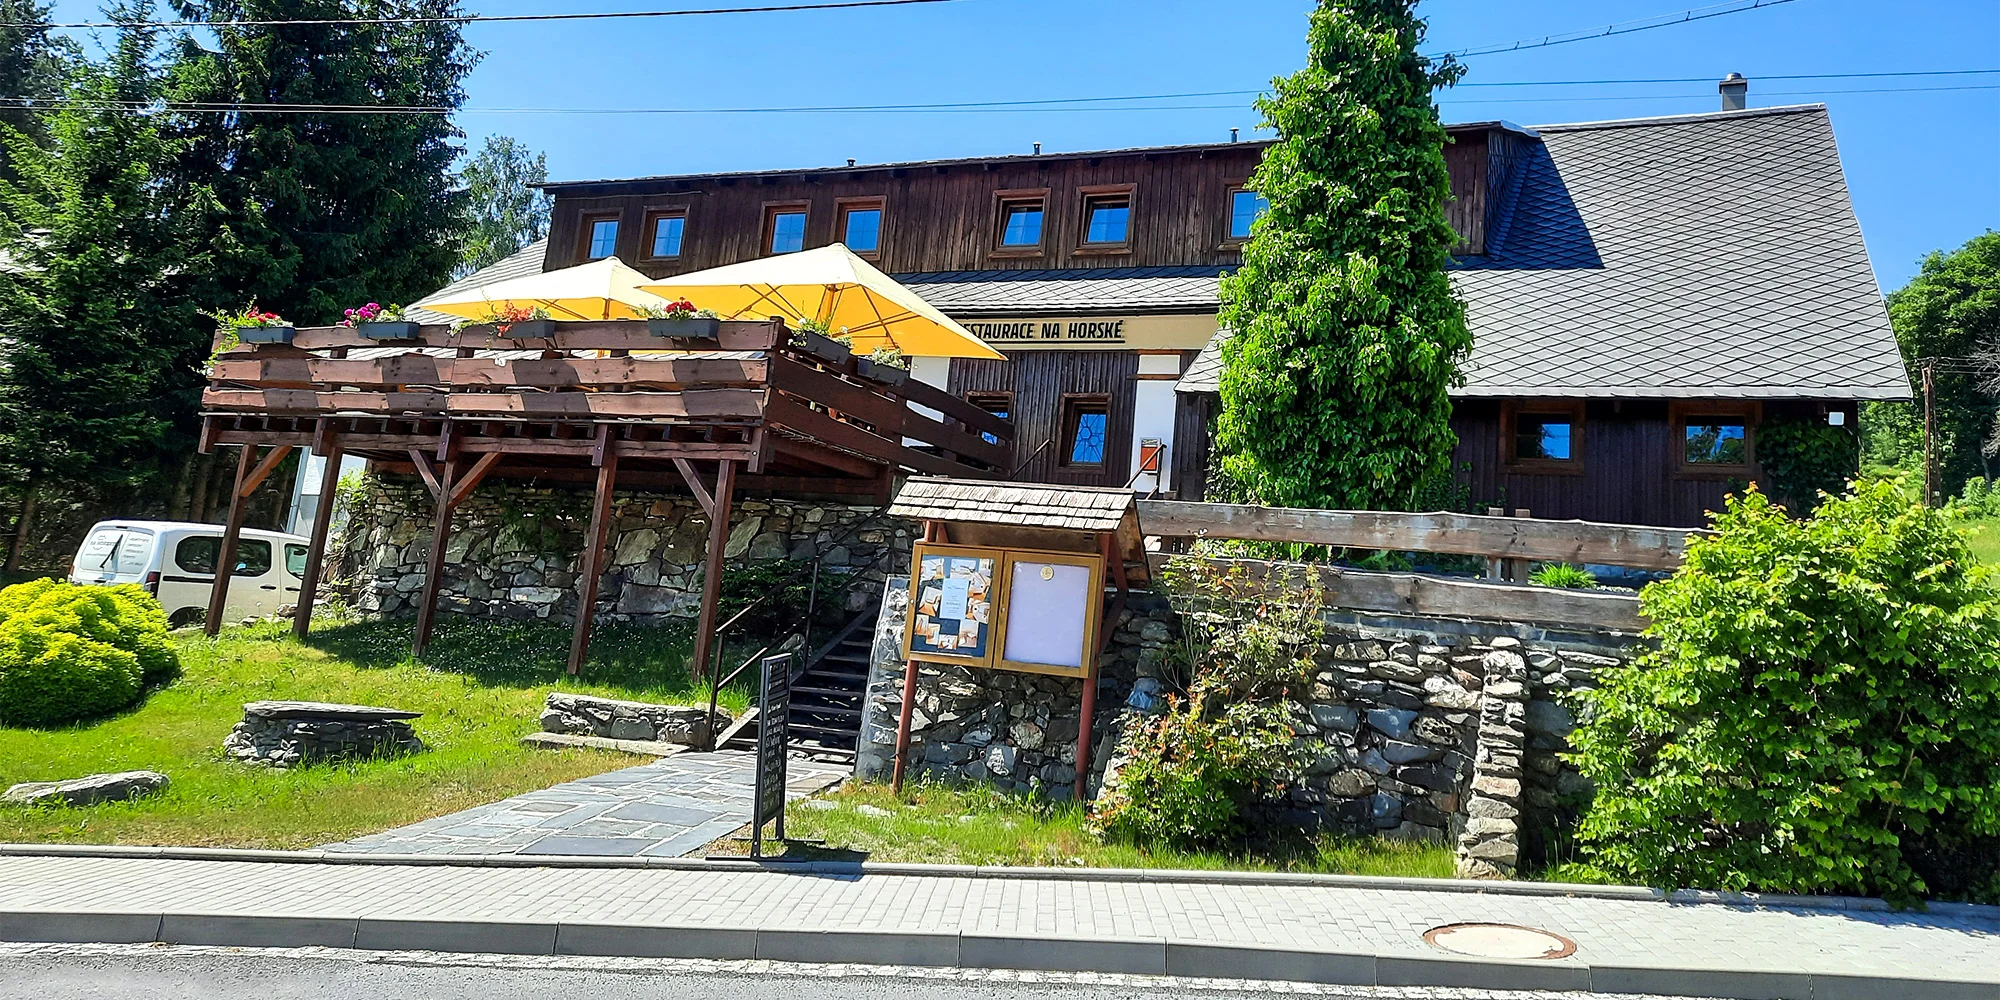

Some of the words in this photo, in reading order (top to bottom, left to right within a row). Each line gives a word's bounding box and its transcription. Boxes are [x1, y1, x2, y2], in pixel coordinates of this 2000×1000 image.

[963, 323, 1035, 339] STAURACE
[1041, 323, 1060, 339] NA
[1068, 319, 1124, 339] HORSKÉ
